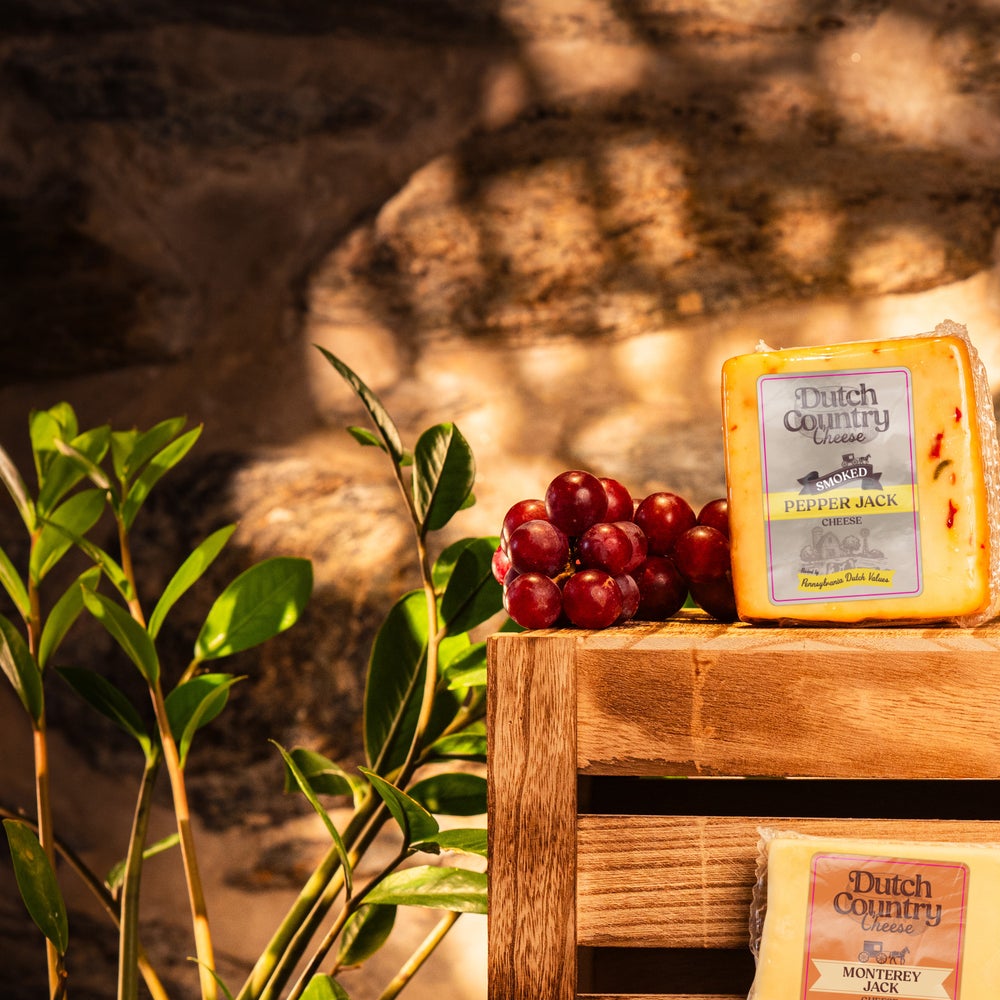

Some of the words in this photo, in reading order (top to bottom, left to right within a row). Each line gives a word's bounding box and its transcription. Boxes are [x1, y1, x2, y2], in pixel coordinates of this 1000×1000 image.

[795, 383, 878, 409] Dutch
[784, 408, 890, 432] Country
[813, 425, 866, 445] Cheese
[816, 467, 867, 491] SMOKED
[784, 497, 850, 513] PEPPER
[855, 494, 898, 508] JACK
[822, 517, 862, 526] CHEESE
[801, 574, 843, 589] Pennsylvania
[844, 572, 865, 582] Dutch
[868, 571, 889, 583] Values
[849, 870, 932, 898] Dutch
[833, 892, 942, 927] Country
[861, 912, 915, 934] Cheese
[843, 967, 921, 982] MONTEREY
[863, 981, 899, 993] JACK
